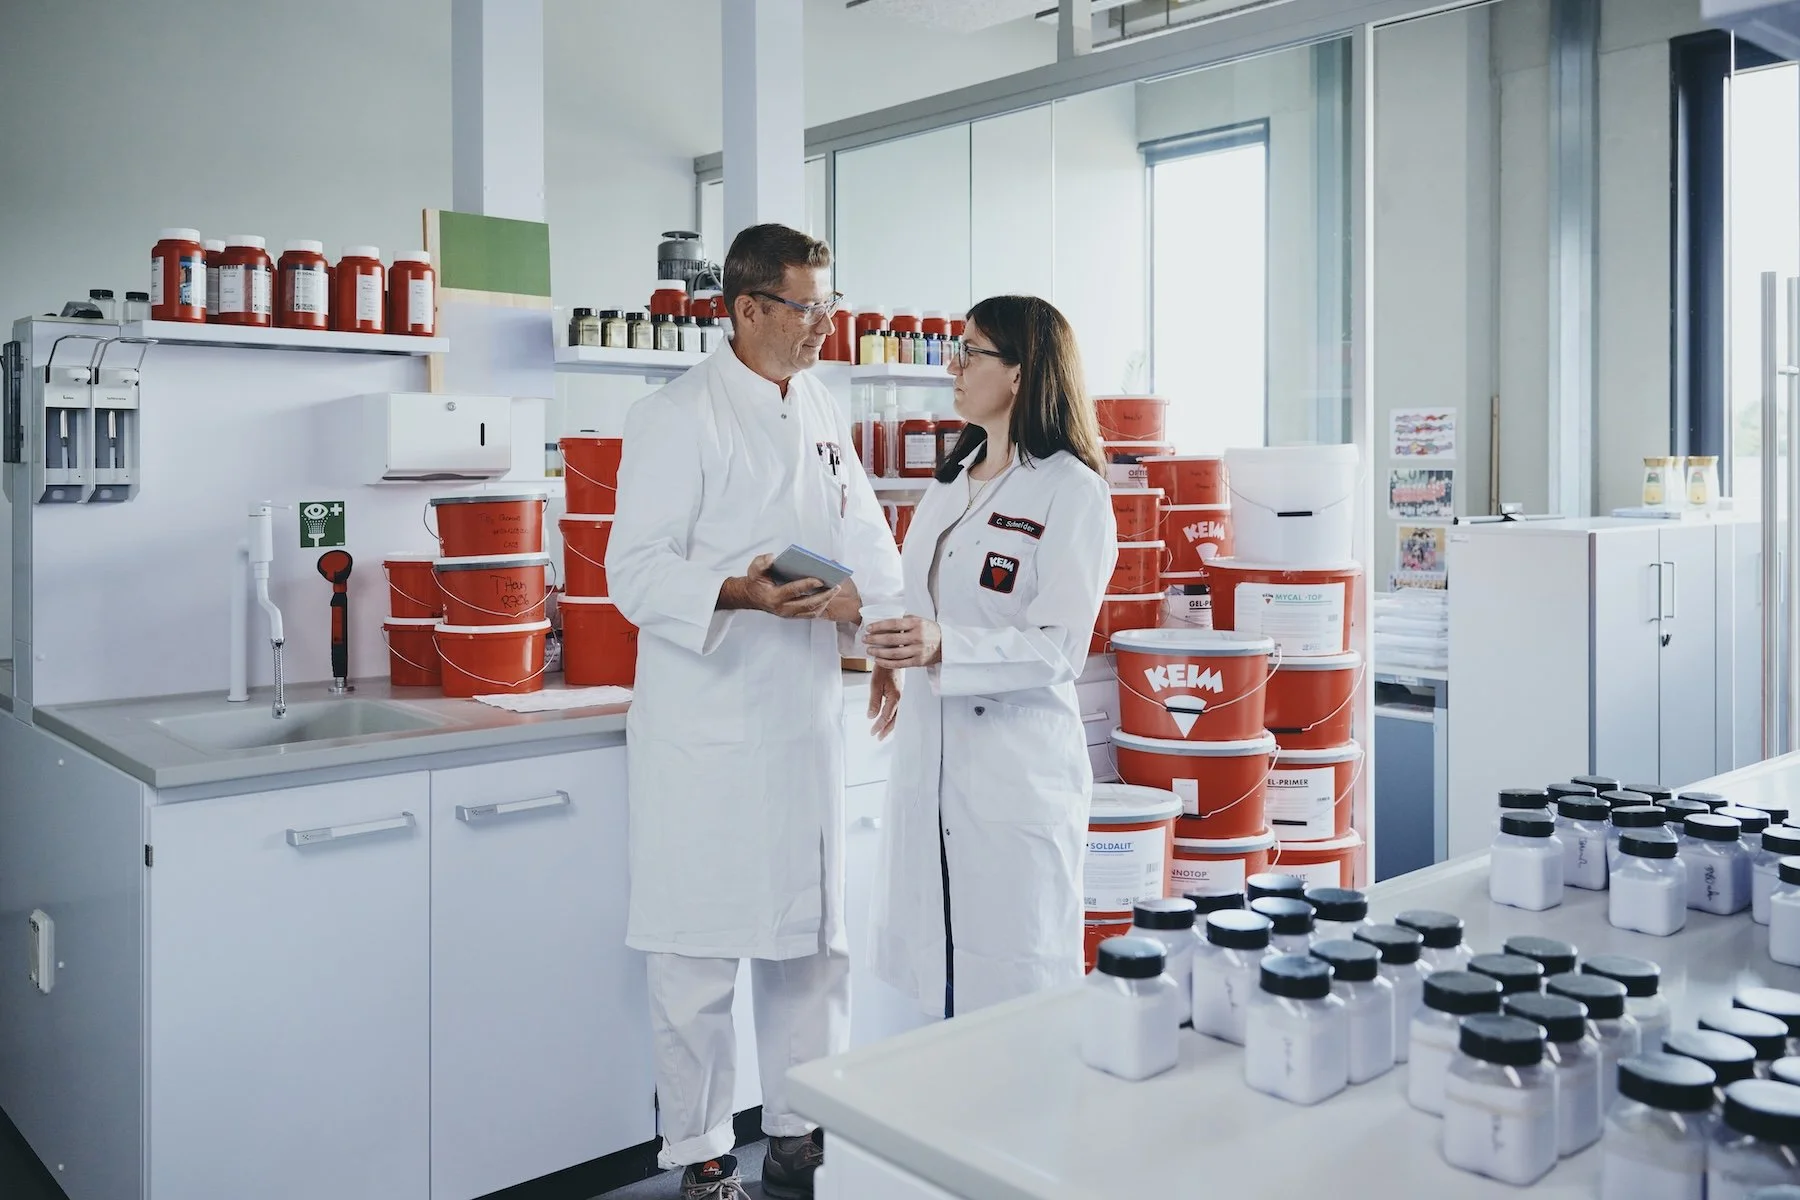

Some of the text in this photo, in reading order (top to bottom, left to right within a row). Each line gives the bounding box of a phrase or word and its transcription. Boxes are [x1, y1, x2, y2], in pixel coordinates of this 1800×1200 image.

[1005, 520, 1035, 533] Schneider
[1182, 520, 1225, 543] KEIM
[989, 556, 1015, 572] KEIM
[1143, 663, 1224, 694] KEIM
[1267, 778, 1309, 786] EL-PRIMER
[1090, 842, 1132, 850] SOLDALIT
